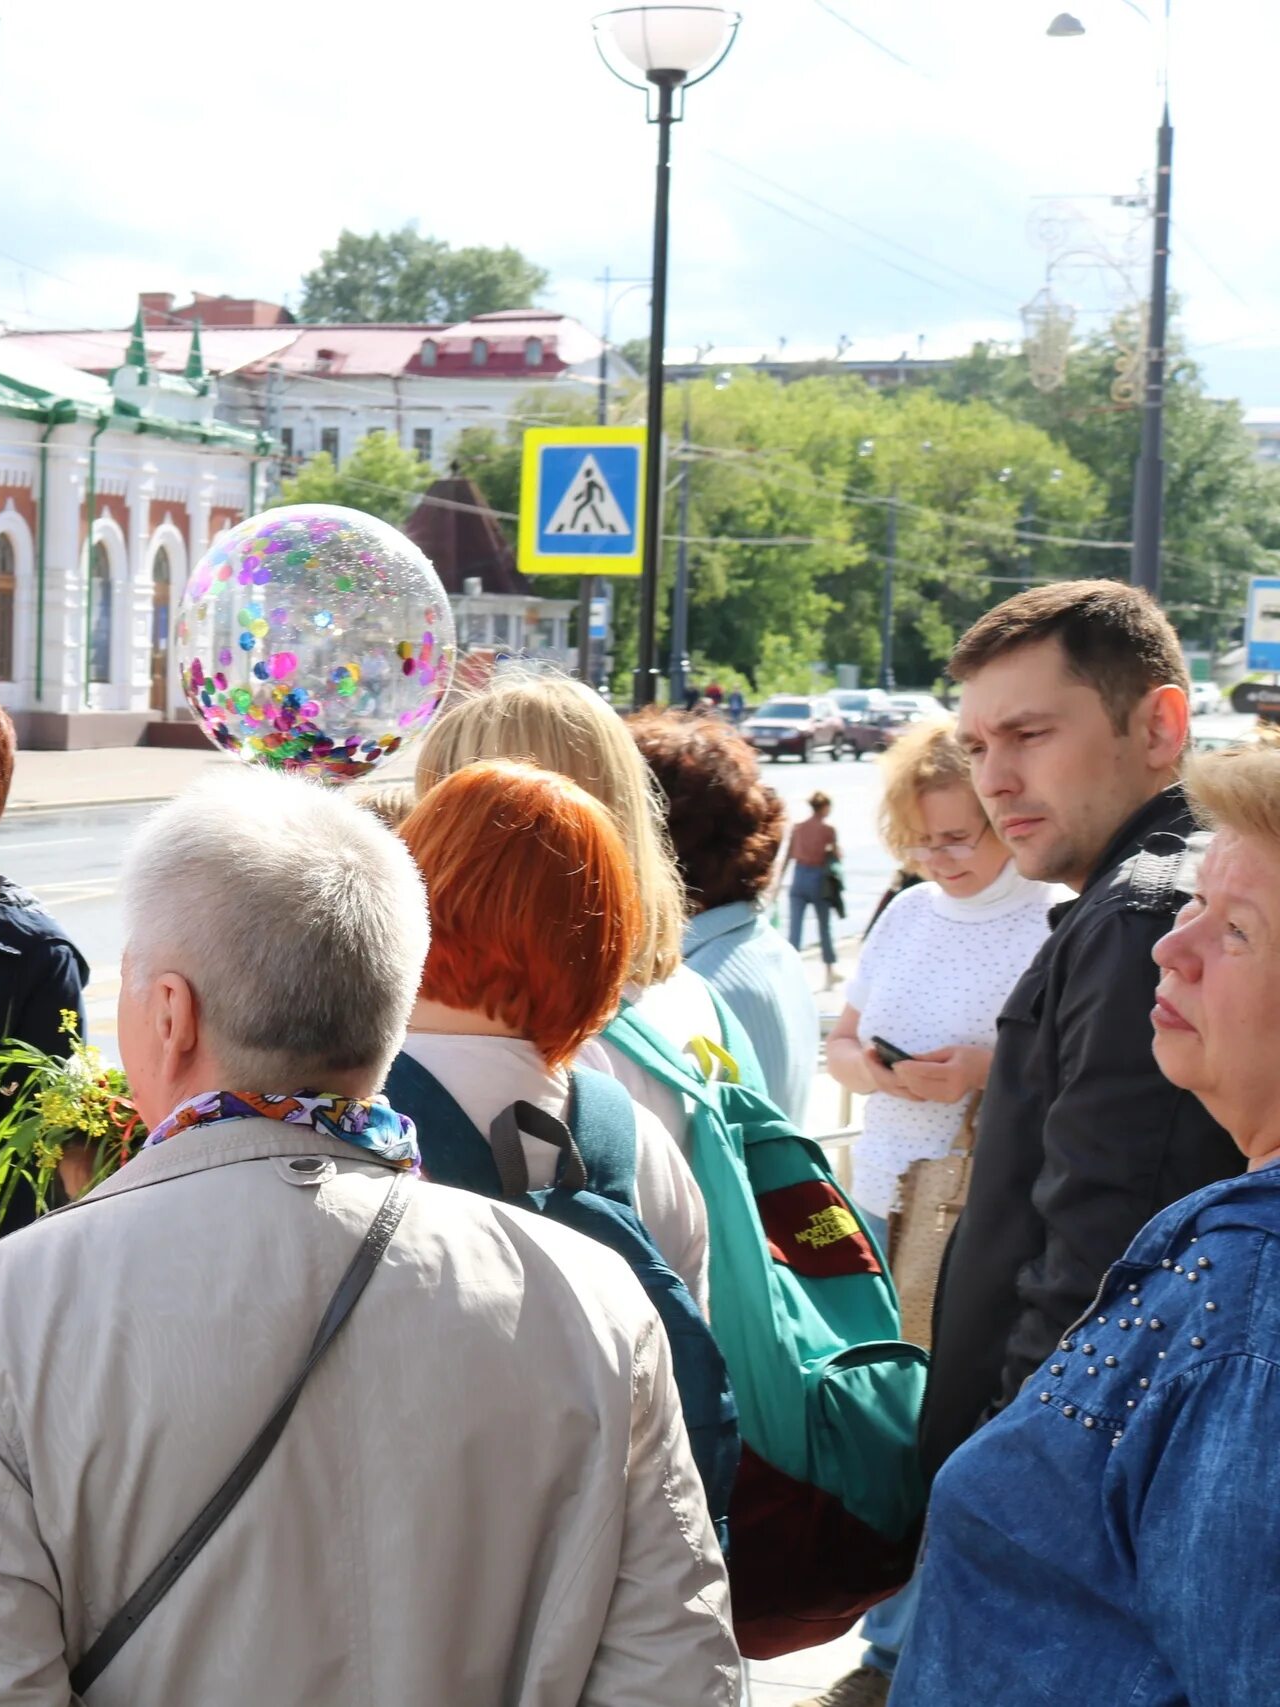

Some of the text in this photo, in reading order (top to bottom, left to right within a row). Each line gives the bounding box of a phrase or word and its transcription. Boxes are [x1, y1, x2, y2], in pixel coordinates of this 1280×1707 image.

[808, 1207, 835, 1225] THE
[795, 1221, 841, 1244] NORTH
[811, 1230, 845, 1250] FACE
